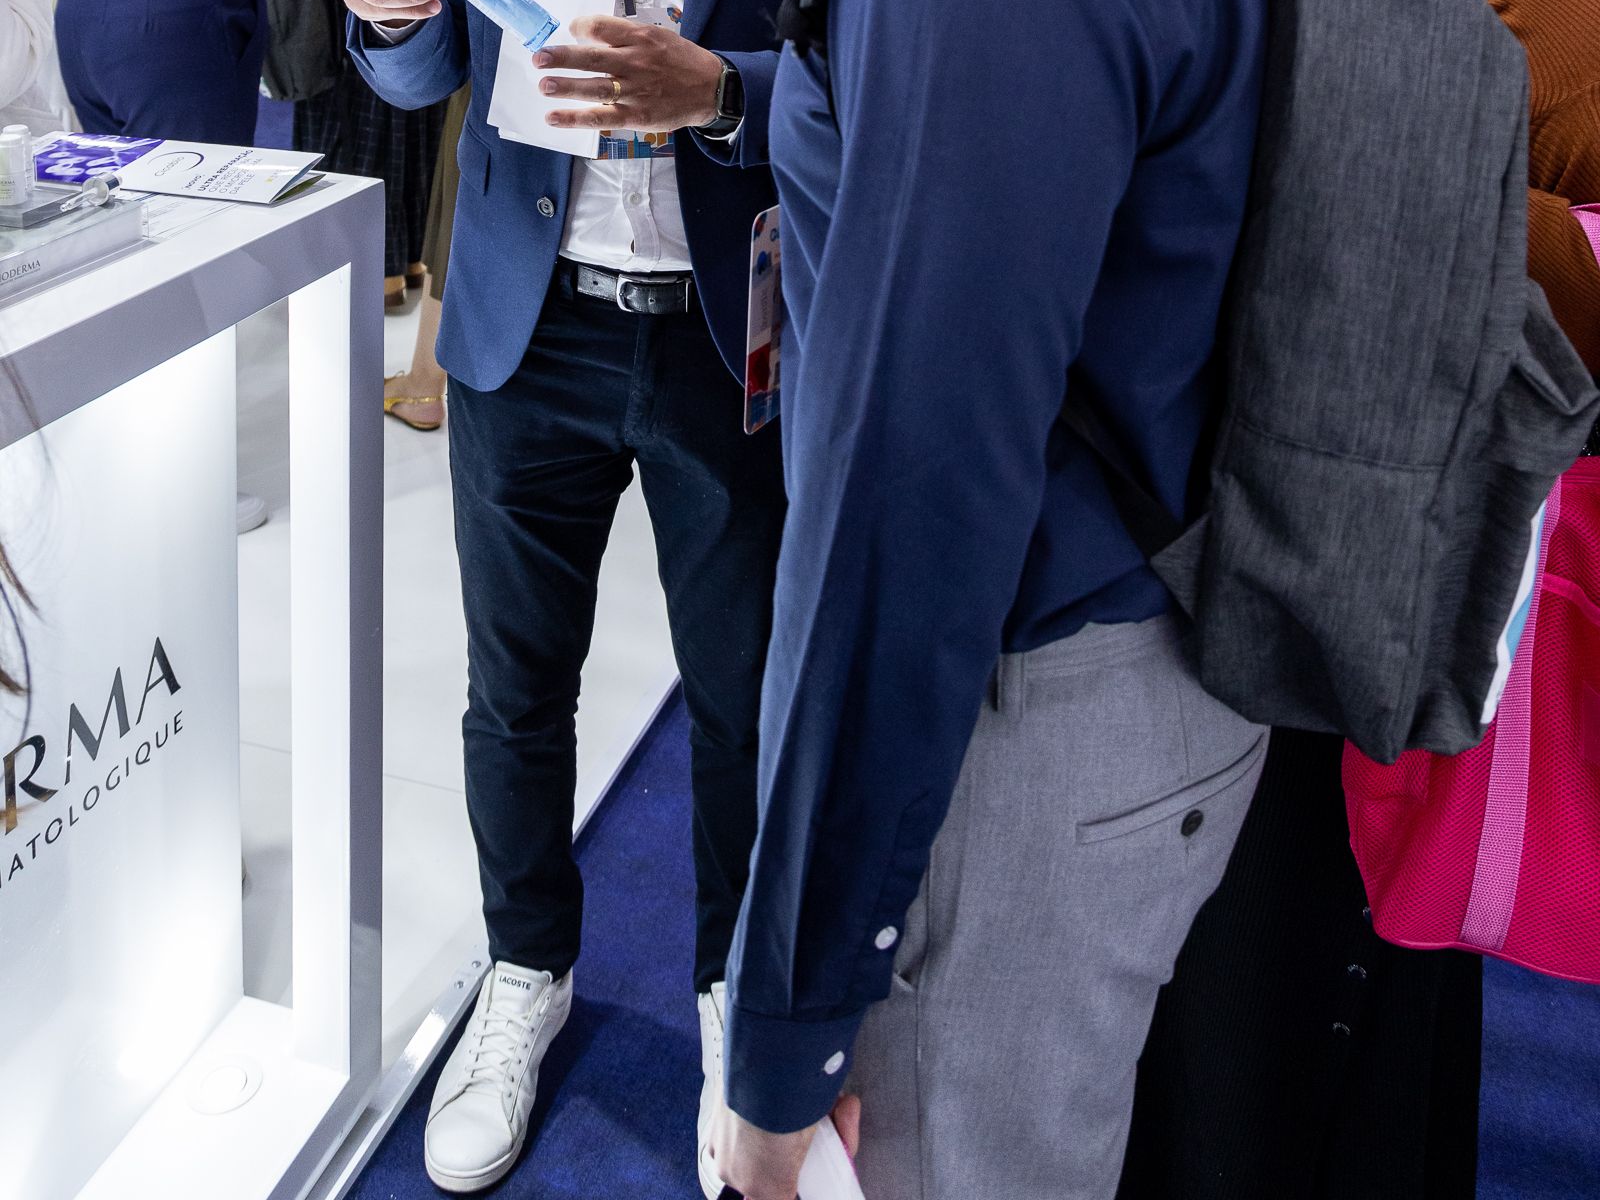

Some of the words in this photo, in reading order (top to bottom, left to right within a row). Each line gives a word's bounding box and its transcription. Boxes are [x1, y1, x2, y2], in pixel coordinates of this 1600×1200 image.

[197, 174, 220, 192] ULTRA
[3, 636, 181, 836] RMA
[0, 710, 183, 888] ATOLOGIQUE
[499, 975, 532, 991] LACOSTE
